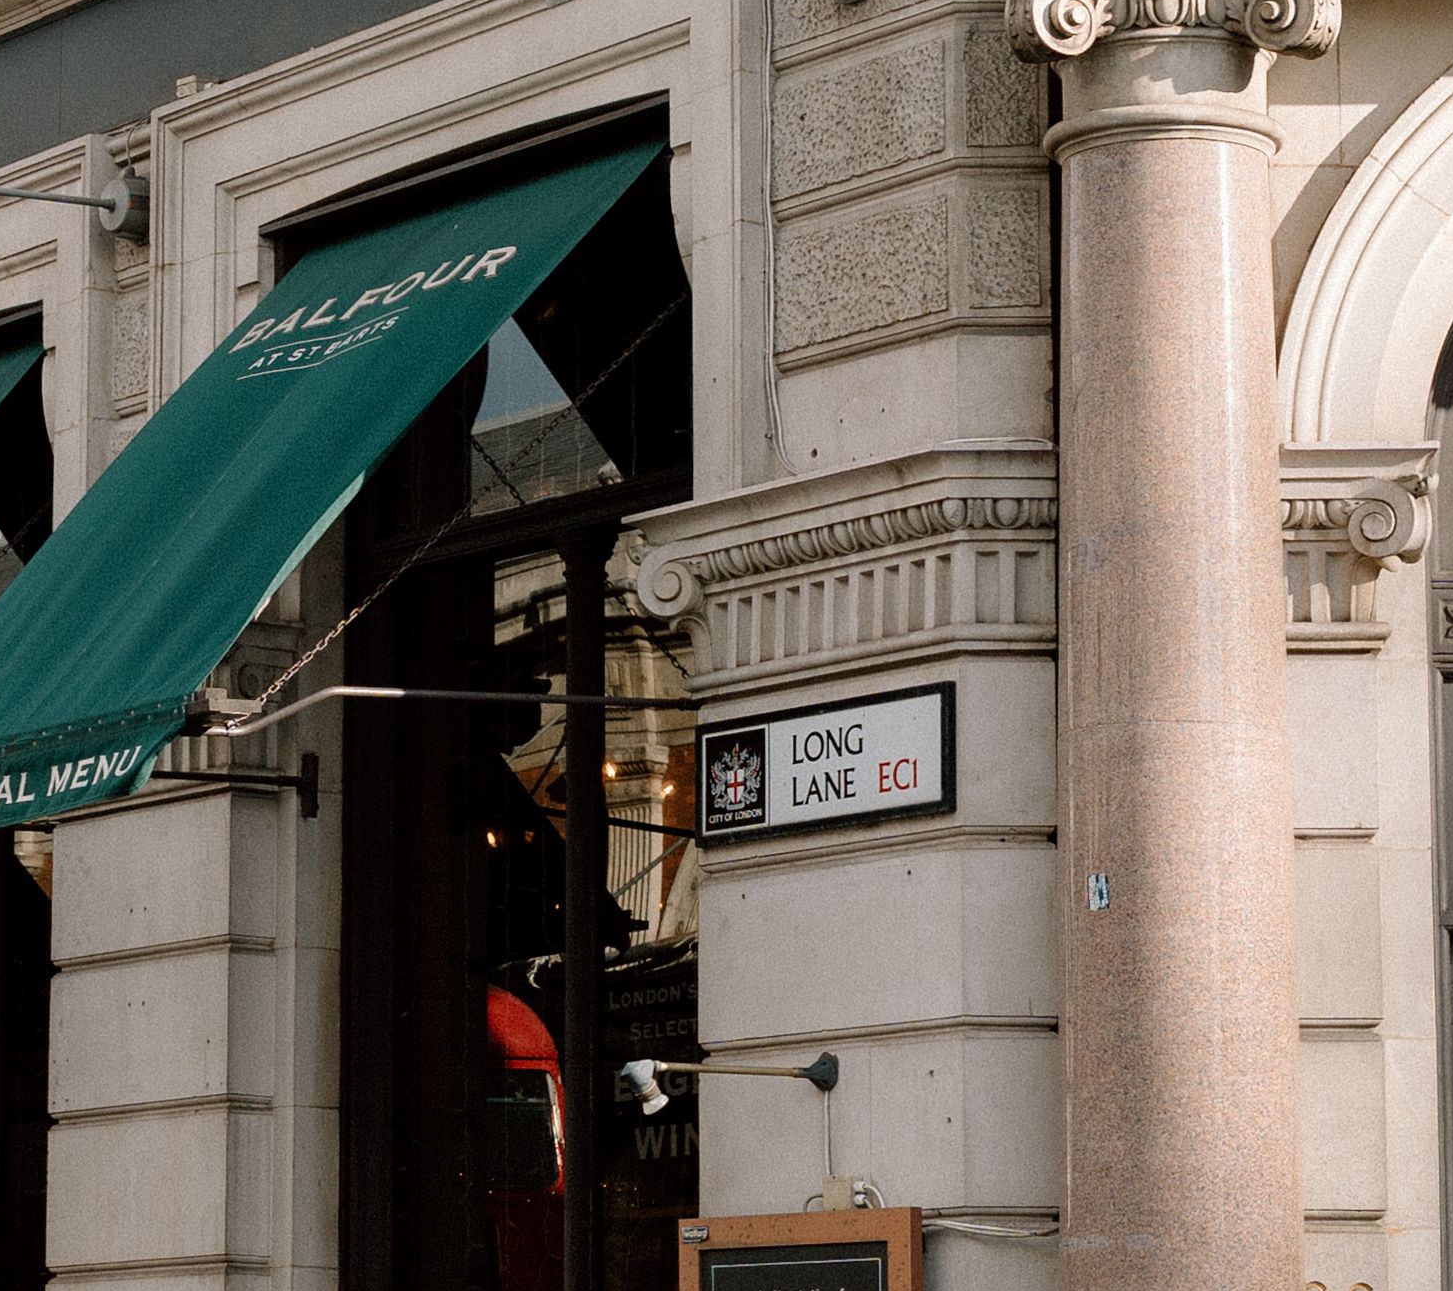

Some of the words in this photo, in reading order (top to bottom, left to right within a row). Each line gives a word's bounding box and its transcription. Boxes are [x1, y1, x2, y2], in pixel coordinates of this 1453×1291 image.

[229, 245, 517, 353] BALFOUR
[248, 353, 282, 371] AT
[324, 315, 400, 355] BARTS
[792, 724, 864, 765] LONG
[47, 746, 142, 797] MENU
[792, 768, 856, 806] LANE
[878, 758, 918, 793] EC1
[709, 814, 723, 824] CITY
[724, 812, 733, 821] OF
[735, 808, 762, 820] LONDON
